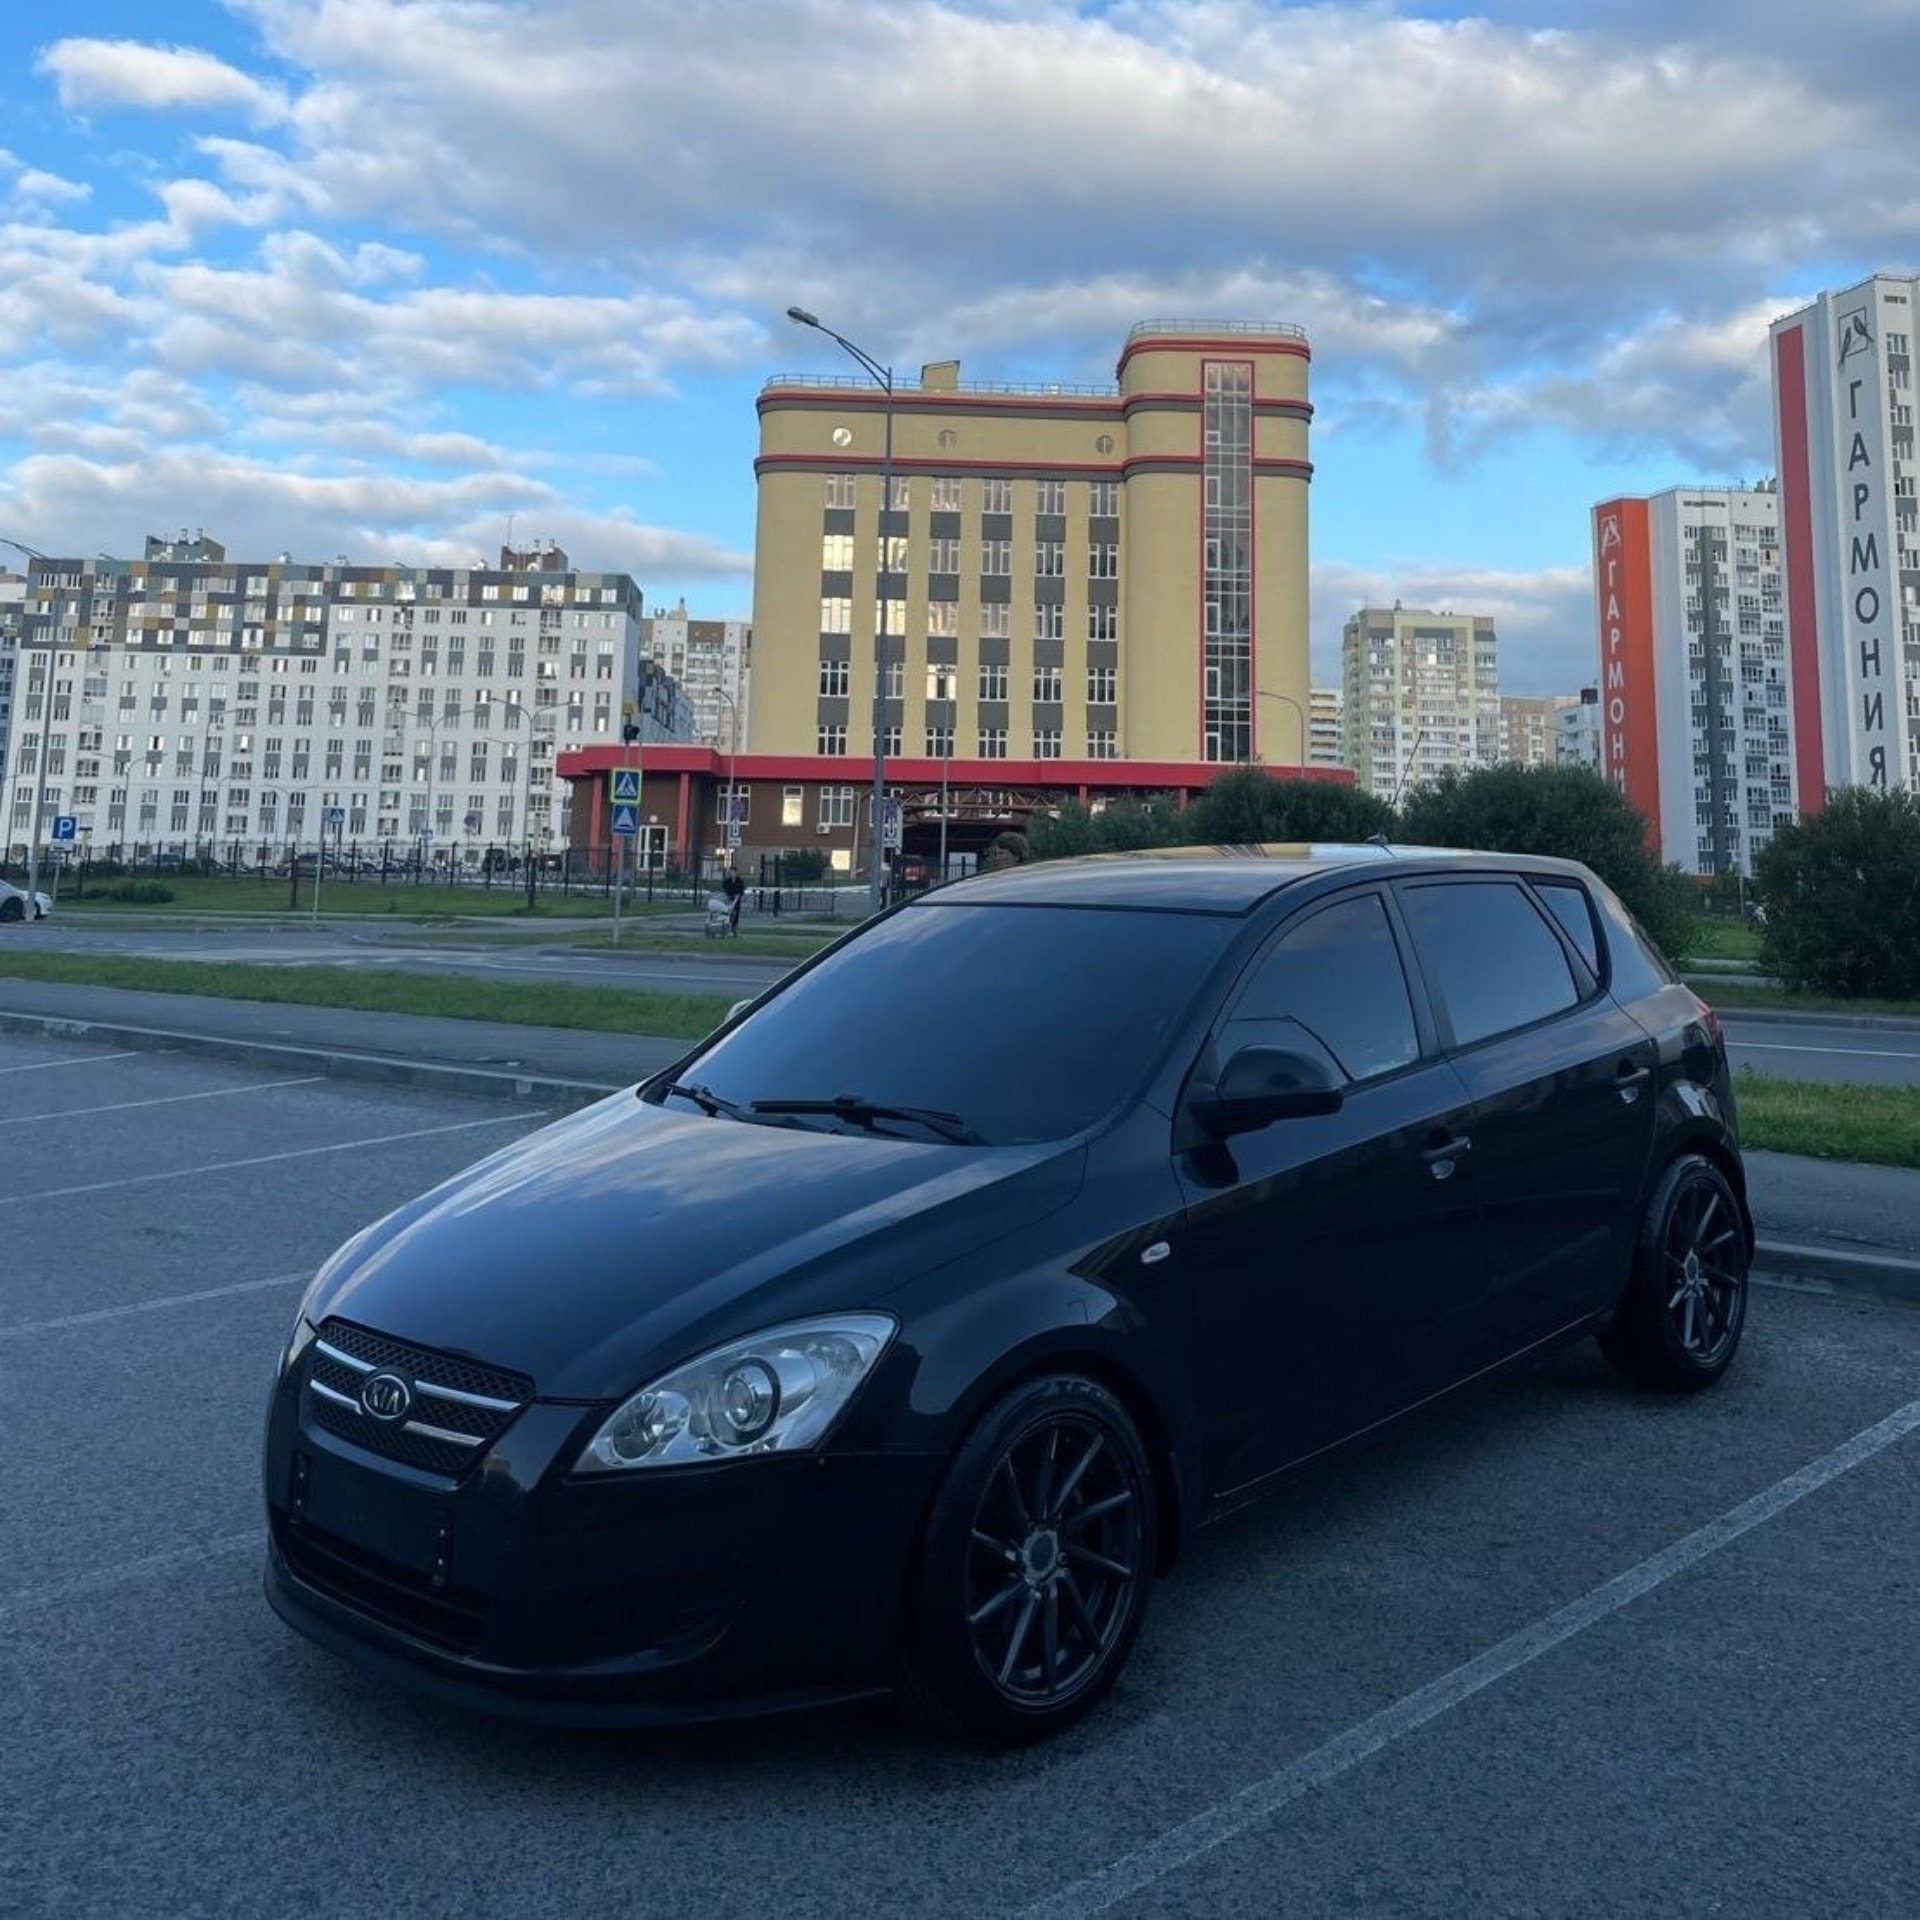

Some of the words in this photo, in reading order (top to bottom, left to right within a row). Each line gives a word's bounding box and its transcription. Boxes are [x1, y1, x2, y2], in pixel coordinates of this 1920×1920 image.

[1848, 380, 1886, 795] ГАРМОНИЯ
[1607, 560, 1625, 794] ГАРМОНИ
[59, 819, 73, 837] P
[369, 1382, 399, 1413] KIA
